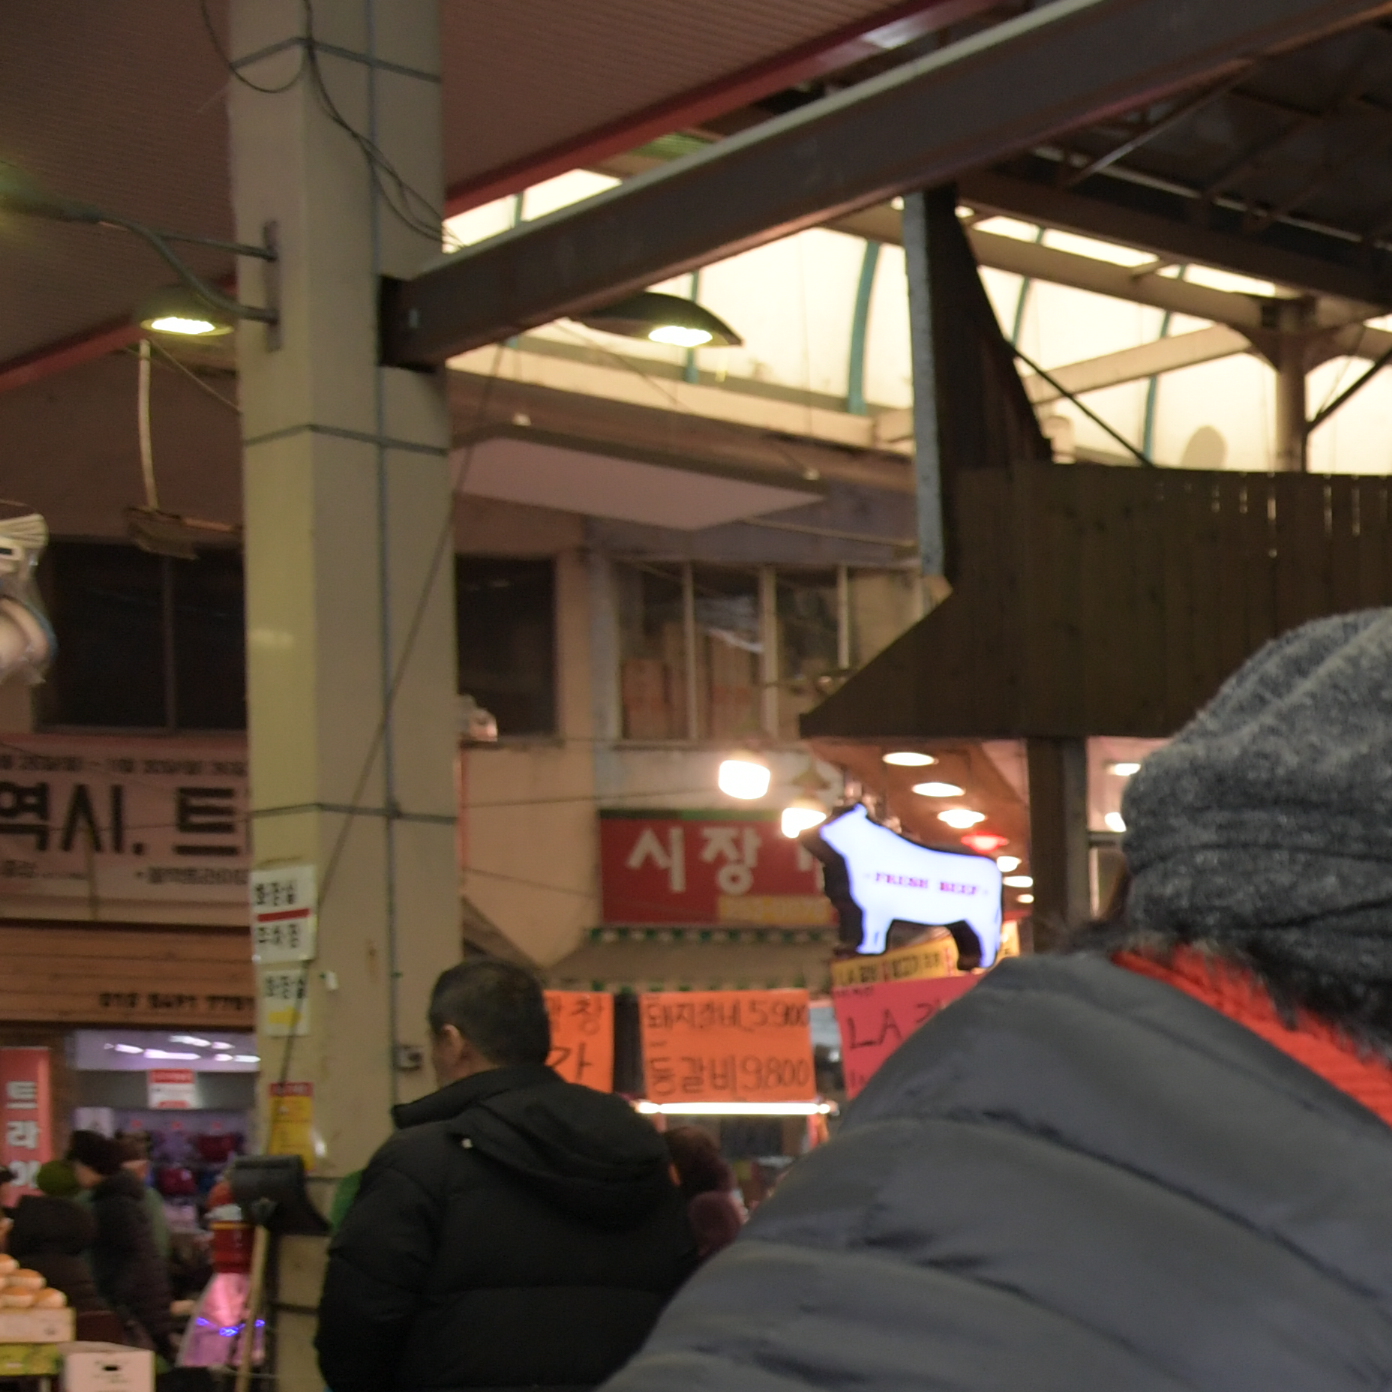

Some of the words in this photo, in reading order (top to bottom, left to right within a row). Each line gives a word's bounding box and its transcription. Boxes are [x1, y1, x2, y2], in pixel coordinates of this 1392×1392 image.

[172, 786, 250, 857] 트
[875, 872, 929, 889] FRESH
[939, 881, 978, 895] BEEF
[847, 1008, 902, 1049] LA
